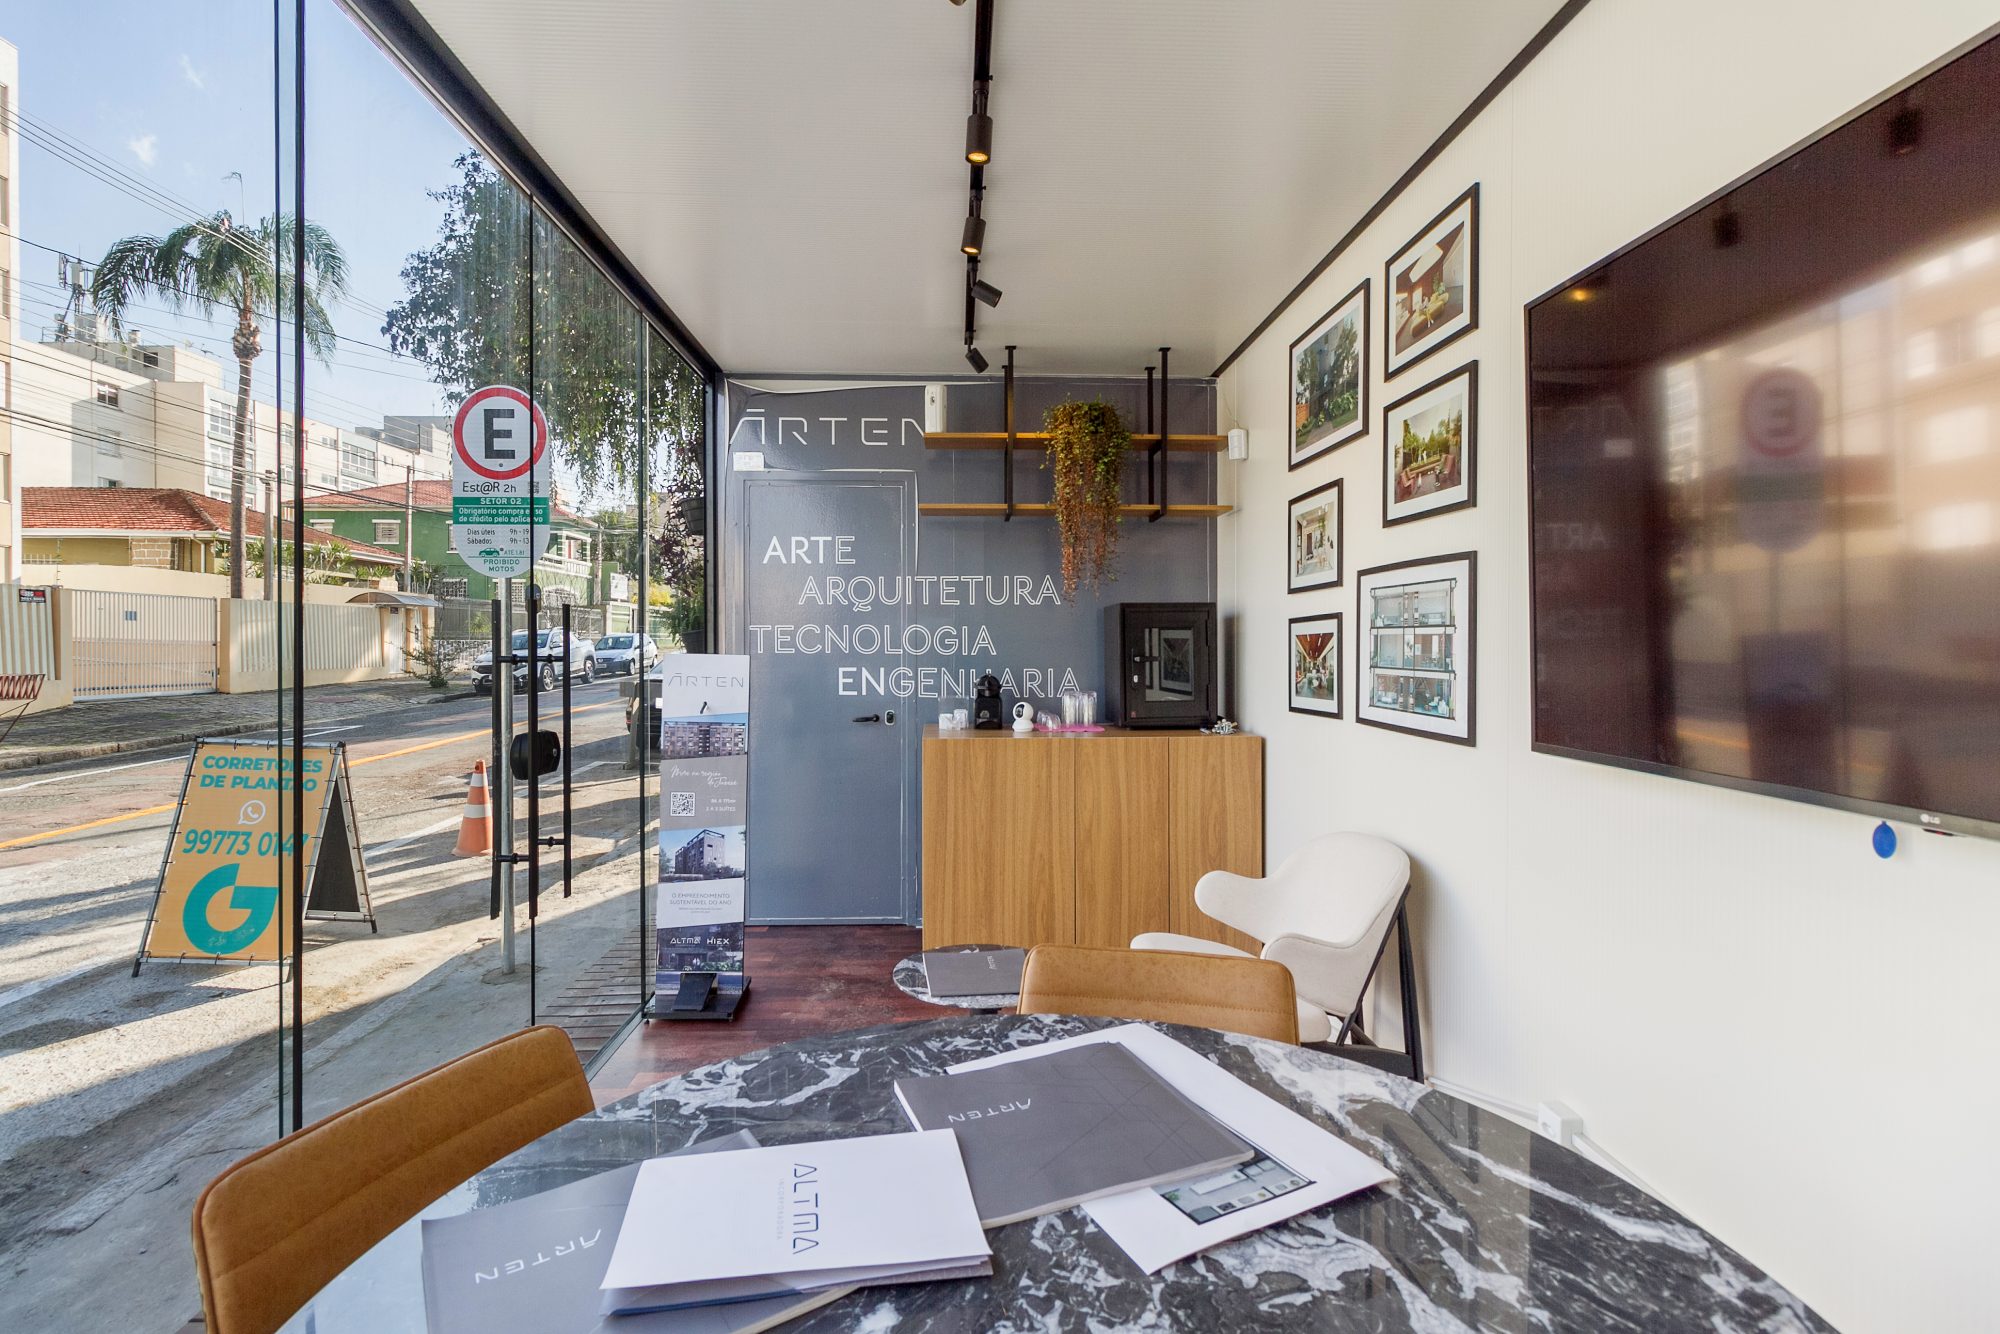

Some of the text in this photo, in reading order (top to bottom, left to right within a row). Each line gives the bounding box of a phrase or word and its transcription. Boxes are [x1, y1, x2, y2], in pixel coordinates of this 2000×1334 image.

[484, 408, 516, 459] E
[462, 482, 516, 494] Est@R 2h
[459, 507, 497, 516] Obrigatório
[498, 508, 524, 516] compra
[762, 535, 856, 565] ARTE
[798, 575, 1061, 612] ARQUITETURA
[750, 624, 997, 656] TECNOLOGIA
[200, 774, 318, 792] DE PLANTO
[182, 828, 253, 856] 99773
[792, 1163, 820, 1255] ALTMA
